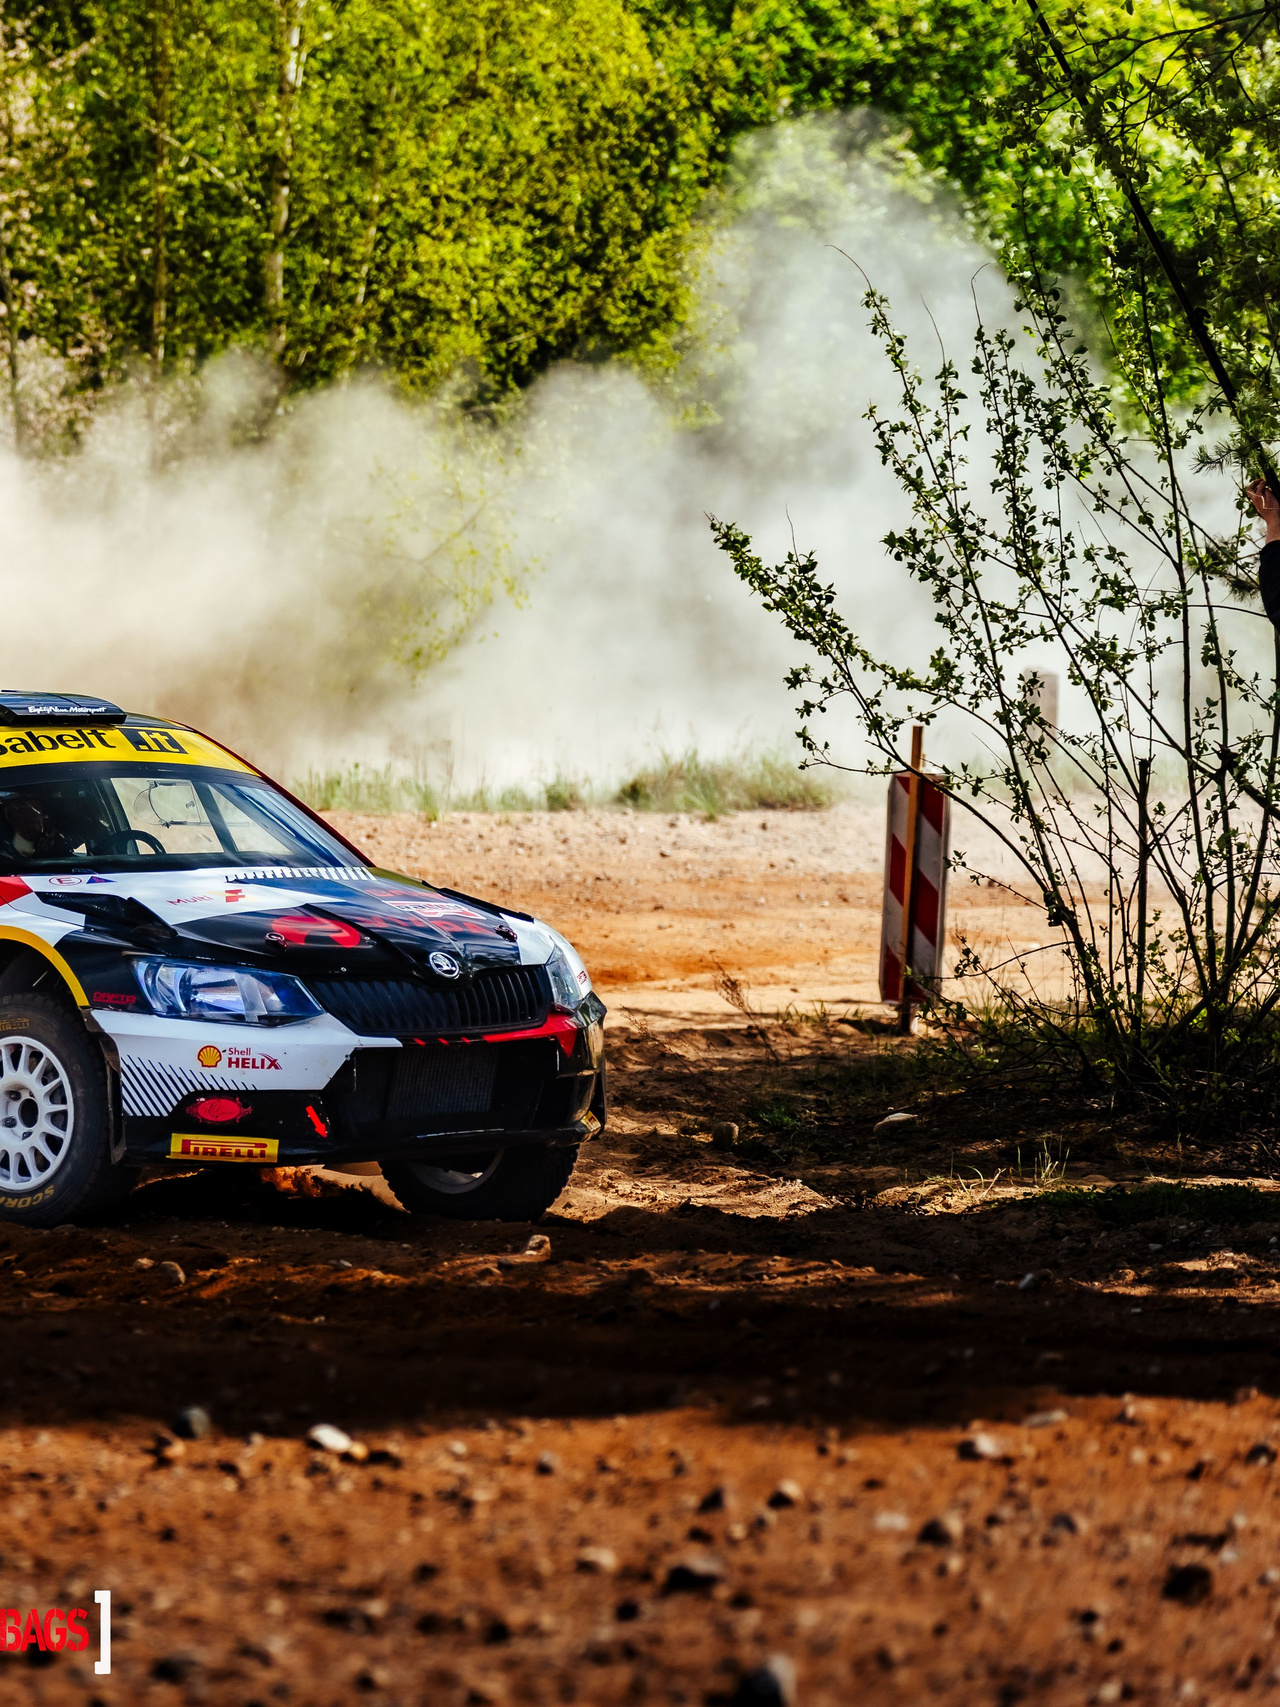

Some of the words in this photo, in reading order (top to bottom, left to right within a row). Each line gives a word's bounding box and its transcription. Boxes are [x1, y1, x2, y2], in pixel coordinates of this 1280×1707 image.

[227, 1047, 251, 1056] Shell
[227, 1053, 282, 1070] HELIX
[181, 1139, 268, 1159] PIRELLI
